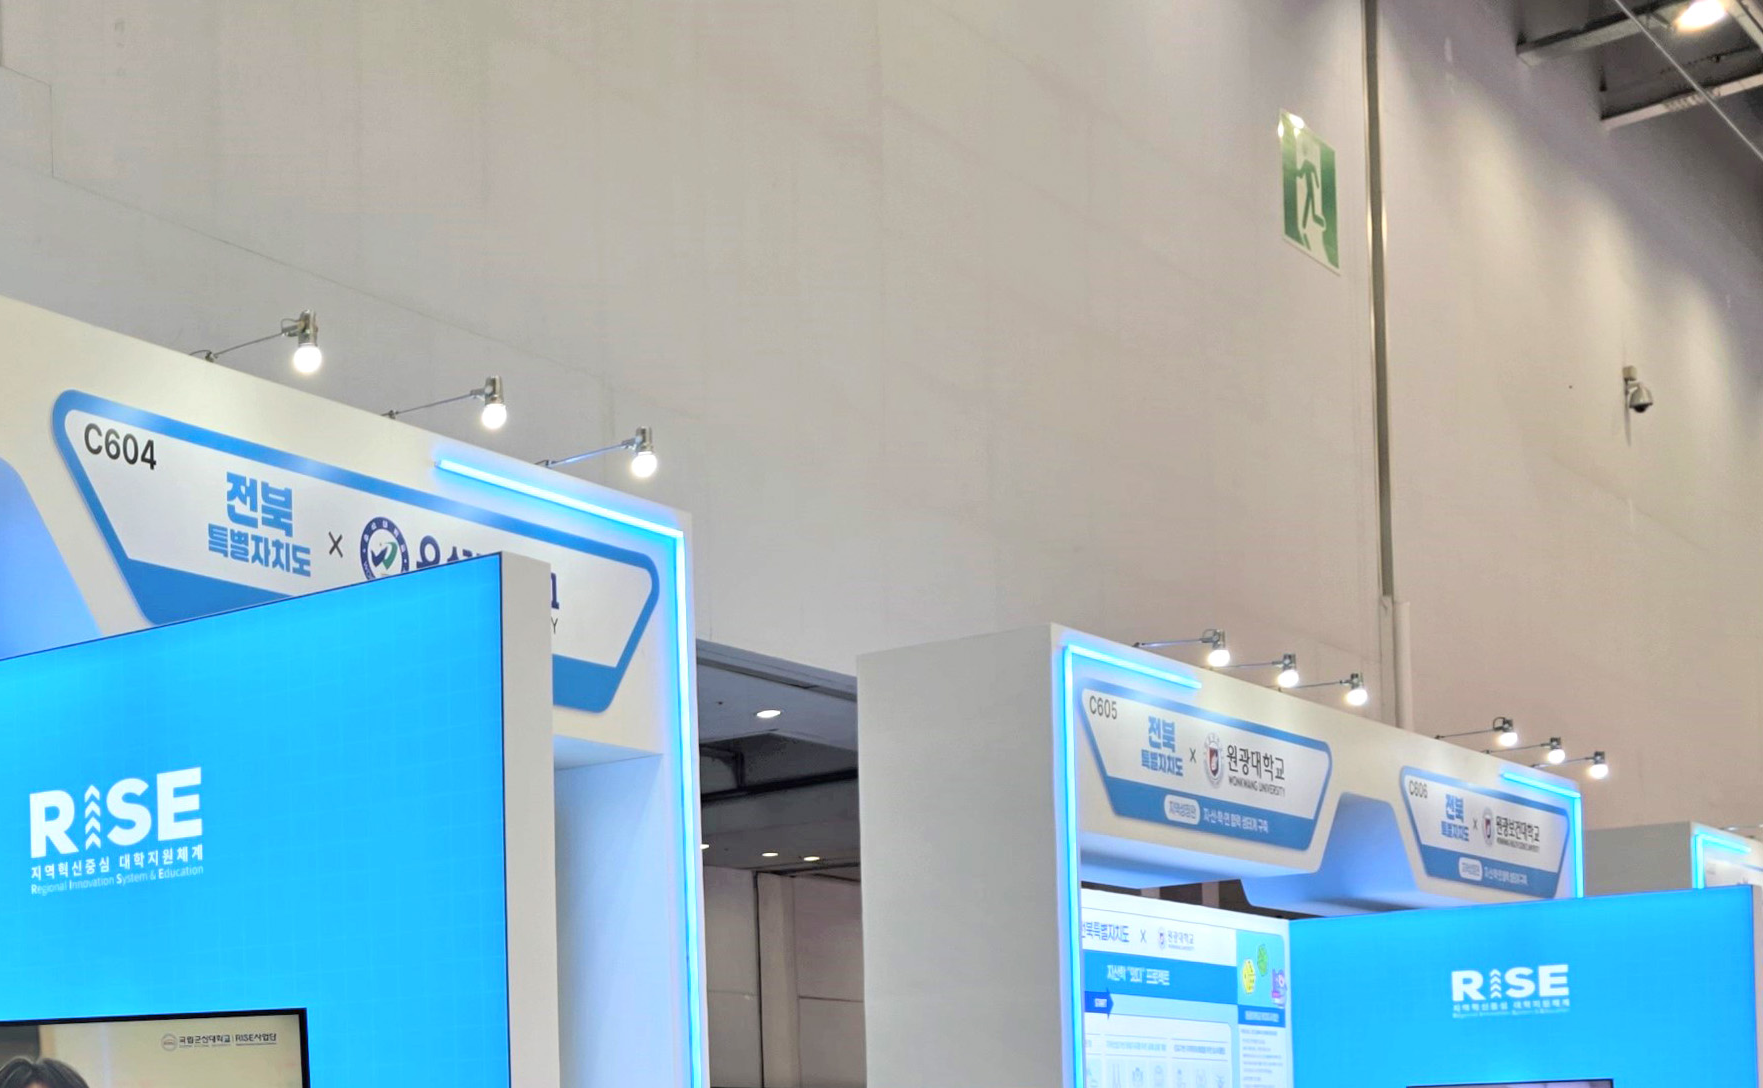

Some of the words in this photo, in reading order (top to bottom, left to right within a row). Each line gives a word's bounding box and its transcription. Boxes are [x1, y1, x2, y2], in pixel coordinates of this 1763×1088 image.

[84, 423, 157, 471] C604
[226, 471, 293, 538] 전북
[208, 523, 312, 578] 특별자치도
[1089, 695, 1118, 720] C605
[1148, 716, 1176, 753] 전북
[1141, 749, 1183, 777] 특별자치도
[1227, 745, 1285, 781] 원광대학교
[29, 766, 203, 859] RISE
[31, 856, 110, 881] 지역혁신중심
[119, 844, 203, 870] 대학지원체계
[31, 881, 67, 896] Regional
[69, 876, 114, 890] Innovation
[116, 872, 148, 886] System
[158, 865, 203, 879] Education
[1451, 964, 1569, 1002] RISE
